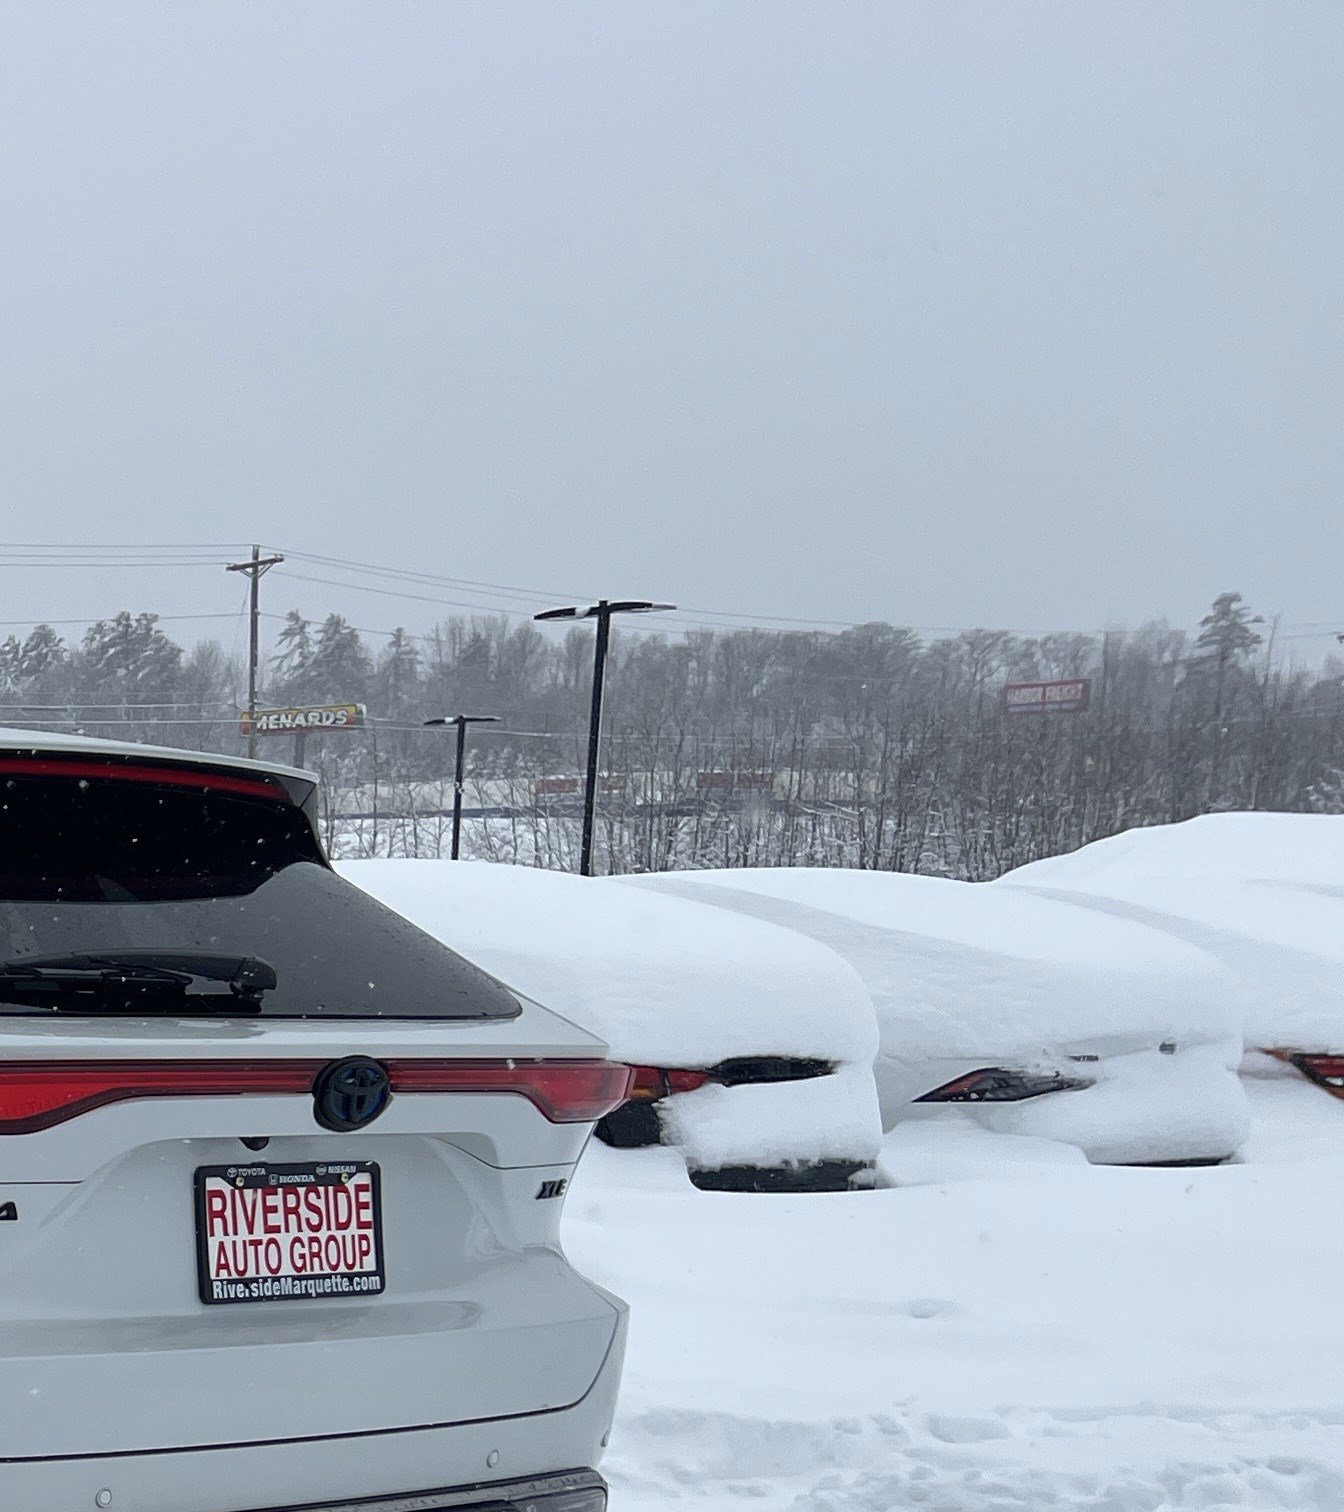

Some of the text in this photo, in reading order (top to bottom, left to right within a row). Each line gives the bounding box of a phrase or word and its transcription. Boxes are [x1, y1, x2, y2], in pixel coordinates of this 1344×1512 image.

[255, 710, 348, 730] MENARDS
[238, 1167, 267, 1177] TOYOTA
[327, 1165, 357, 1174] NISSAN
[279, 1174, 316, 1184] HONDA
[206, 1183, 374, 1237] RIVERSIDE
[215, 1233, 371, 1278] AUTO GROUP
